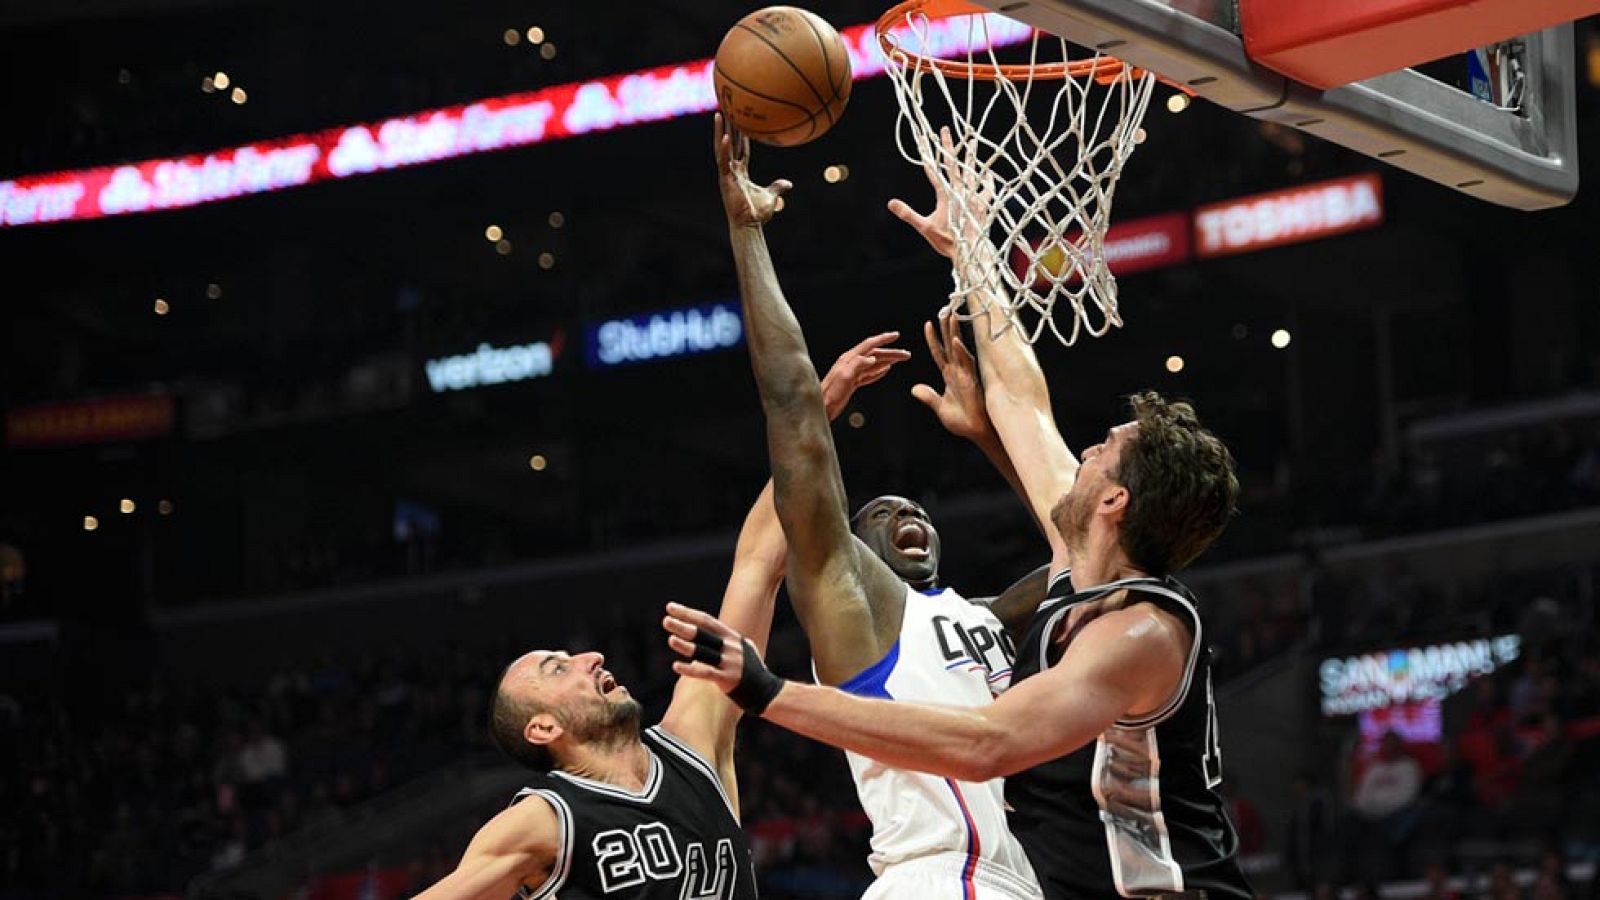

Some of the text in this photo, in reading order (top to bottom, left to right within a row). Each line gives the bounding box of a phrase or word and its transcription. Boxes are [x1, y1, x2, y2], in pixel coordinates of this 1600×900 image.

[1196, 181, 1380, 252] TOSHIBA
[426, 341, 552, 392] verizon
[598, 304, 742, 364] StubHub
[592, 821, 683, 894] 20
